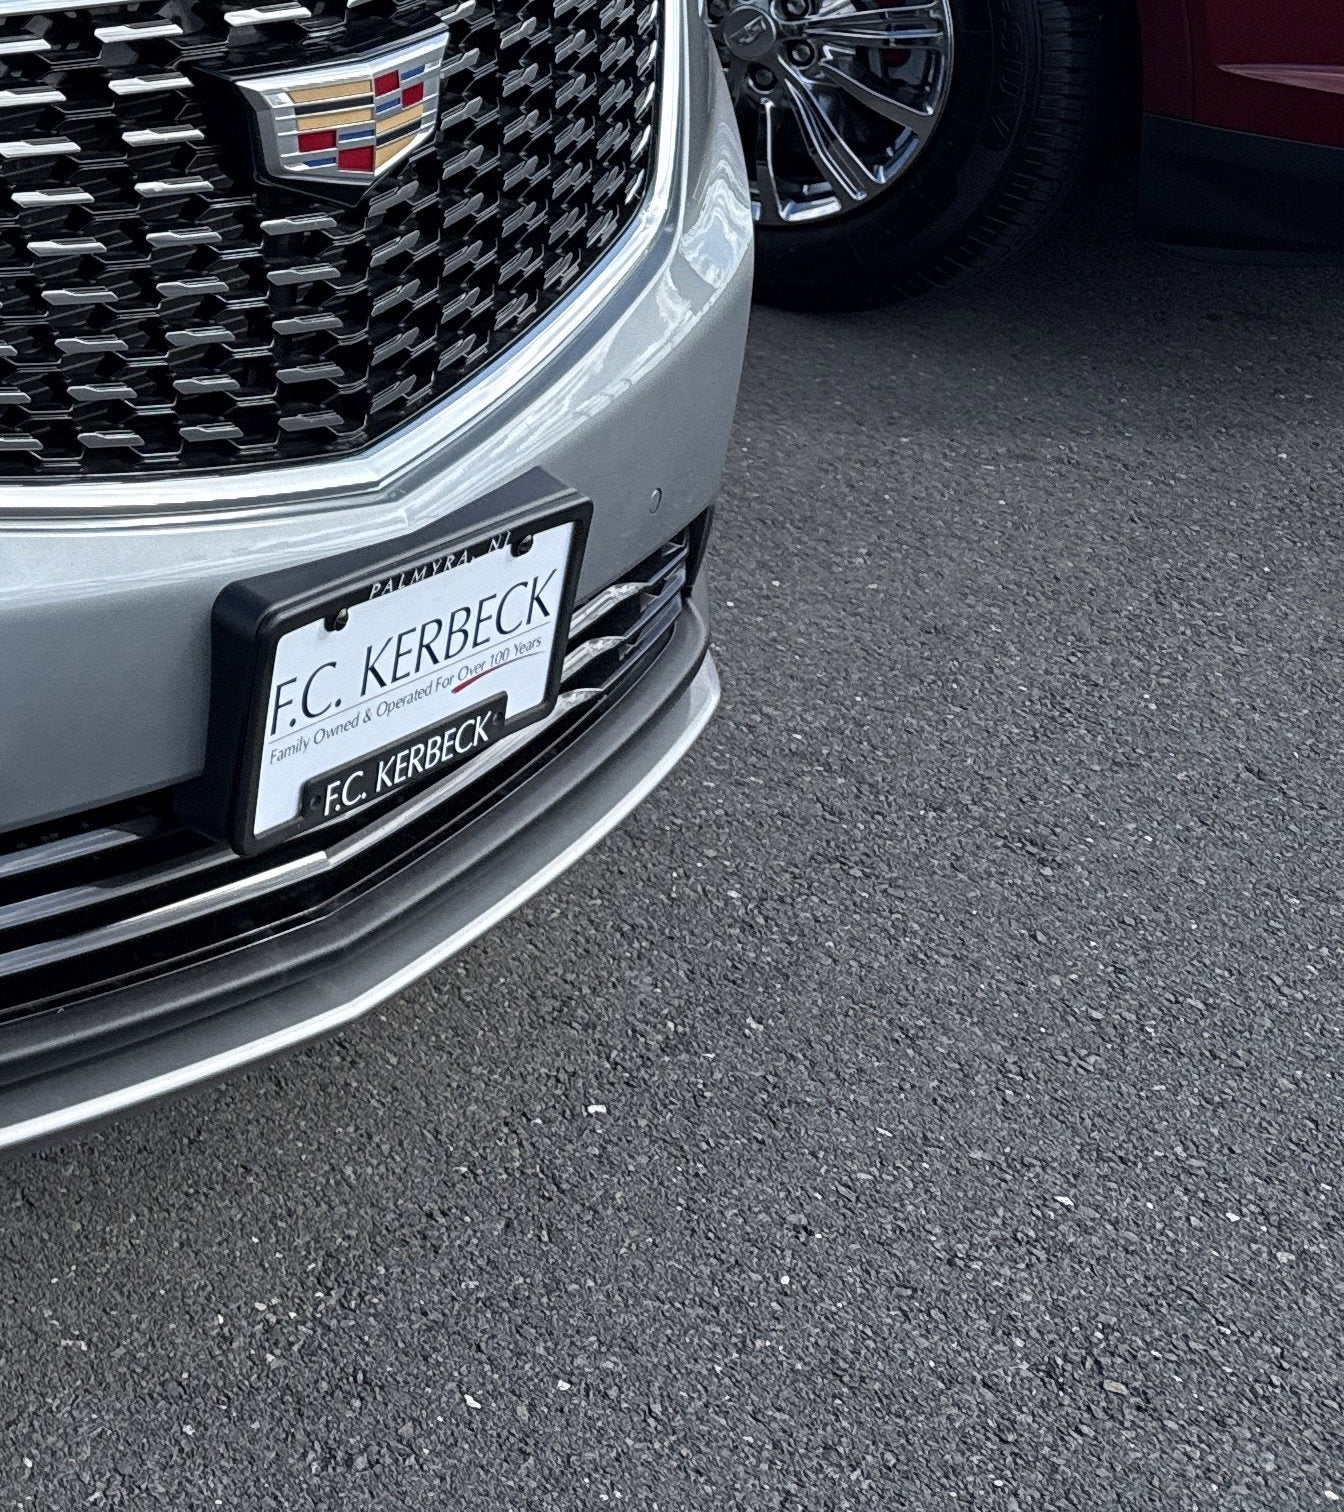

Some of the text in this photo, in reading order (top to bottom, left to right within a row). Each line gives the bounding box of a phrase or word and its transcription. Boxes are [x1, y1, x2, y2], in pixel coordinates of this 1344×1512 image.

[270, 568, 558, 736] F.C. KERBECK
[270, 637, 541, 765] Family Owned & Operated For Over 100 Years
[324, 711, 492, 816] F.C. KERBECK
